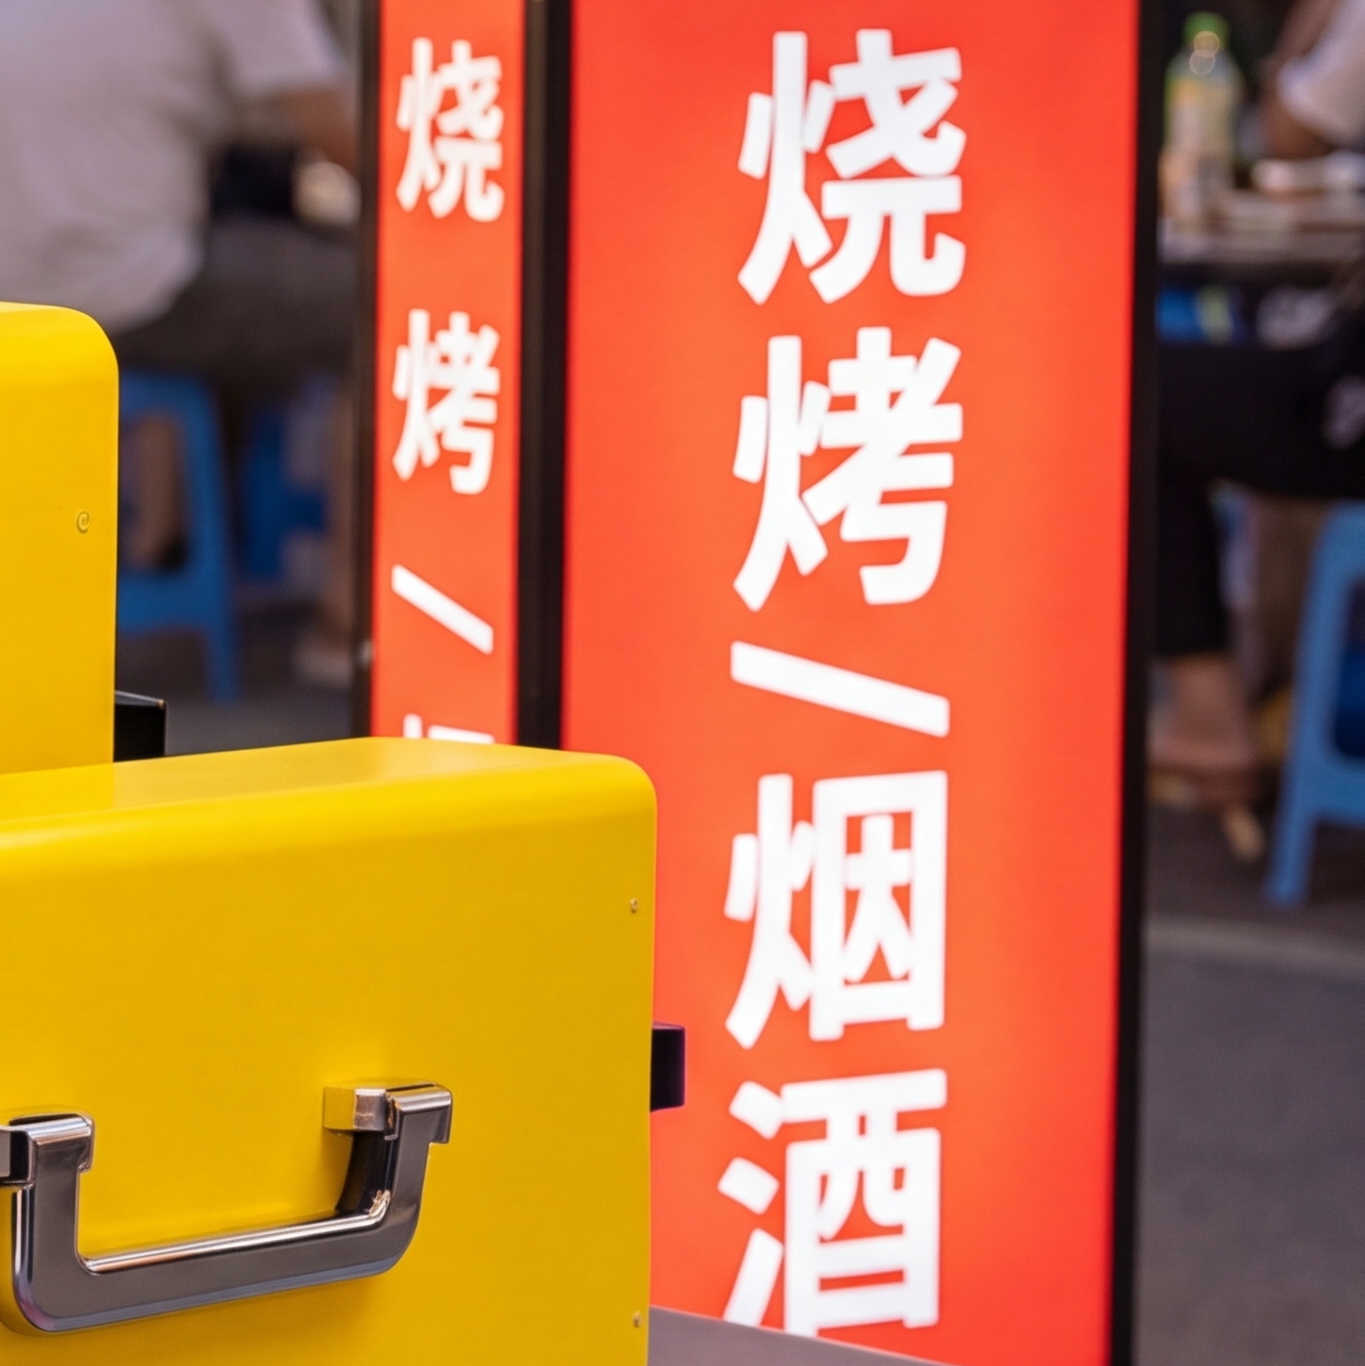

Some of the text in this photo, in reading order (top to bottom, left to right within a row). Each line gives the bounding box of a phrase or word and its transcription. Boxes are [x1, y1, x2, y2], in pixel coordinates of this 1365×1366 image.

[390, 37, 505, 744] 烧烤/
[717, 29, 966, 1337] 烧烤/烟酒
